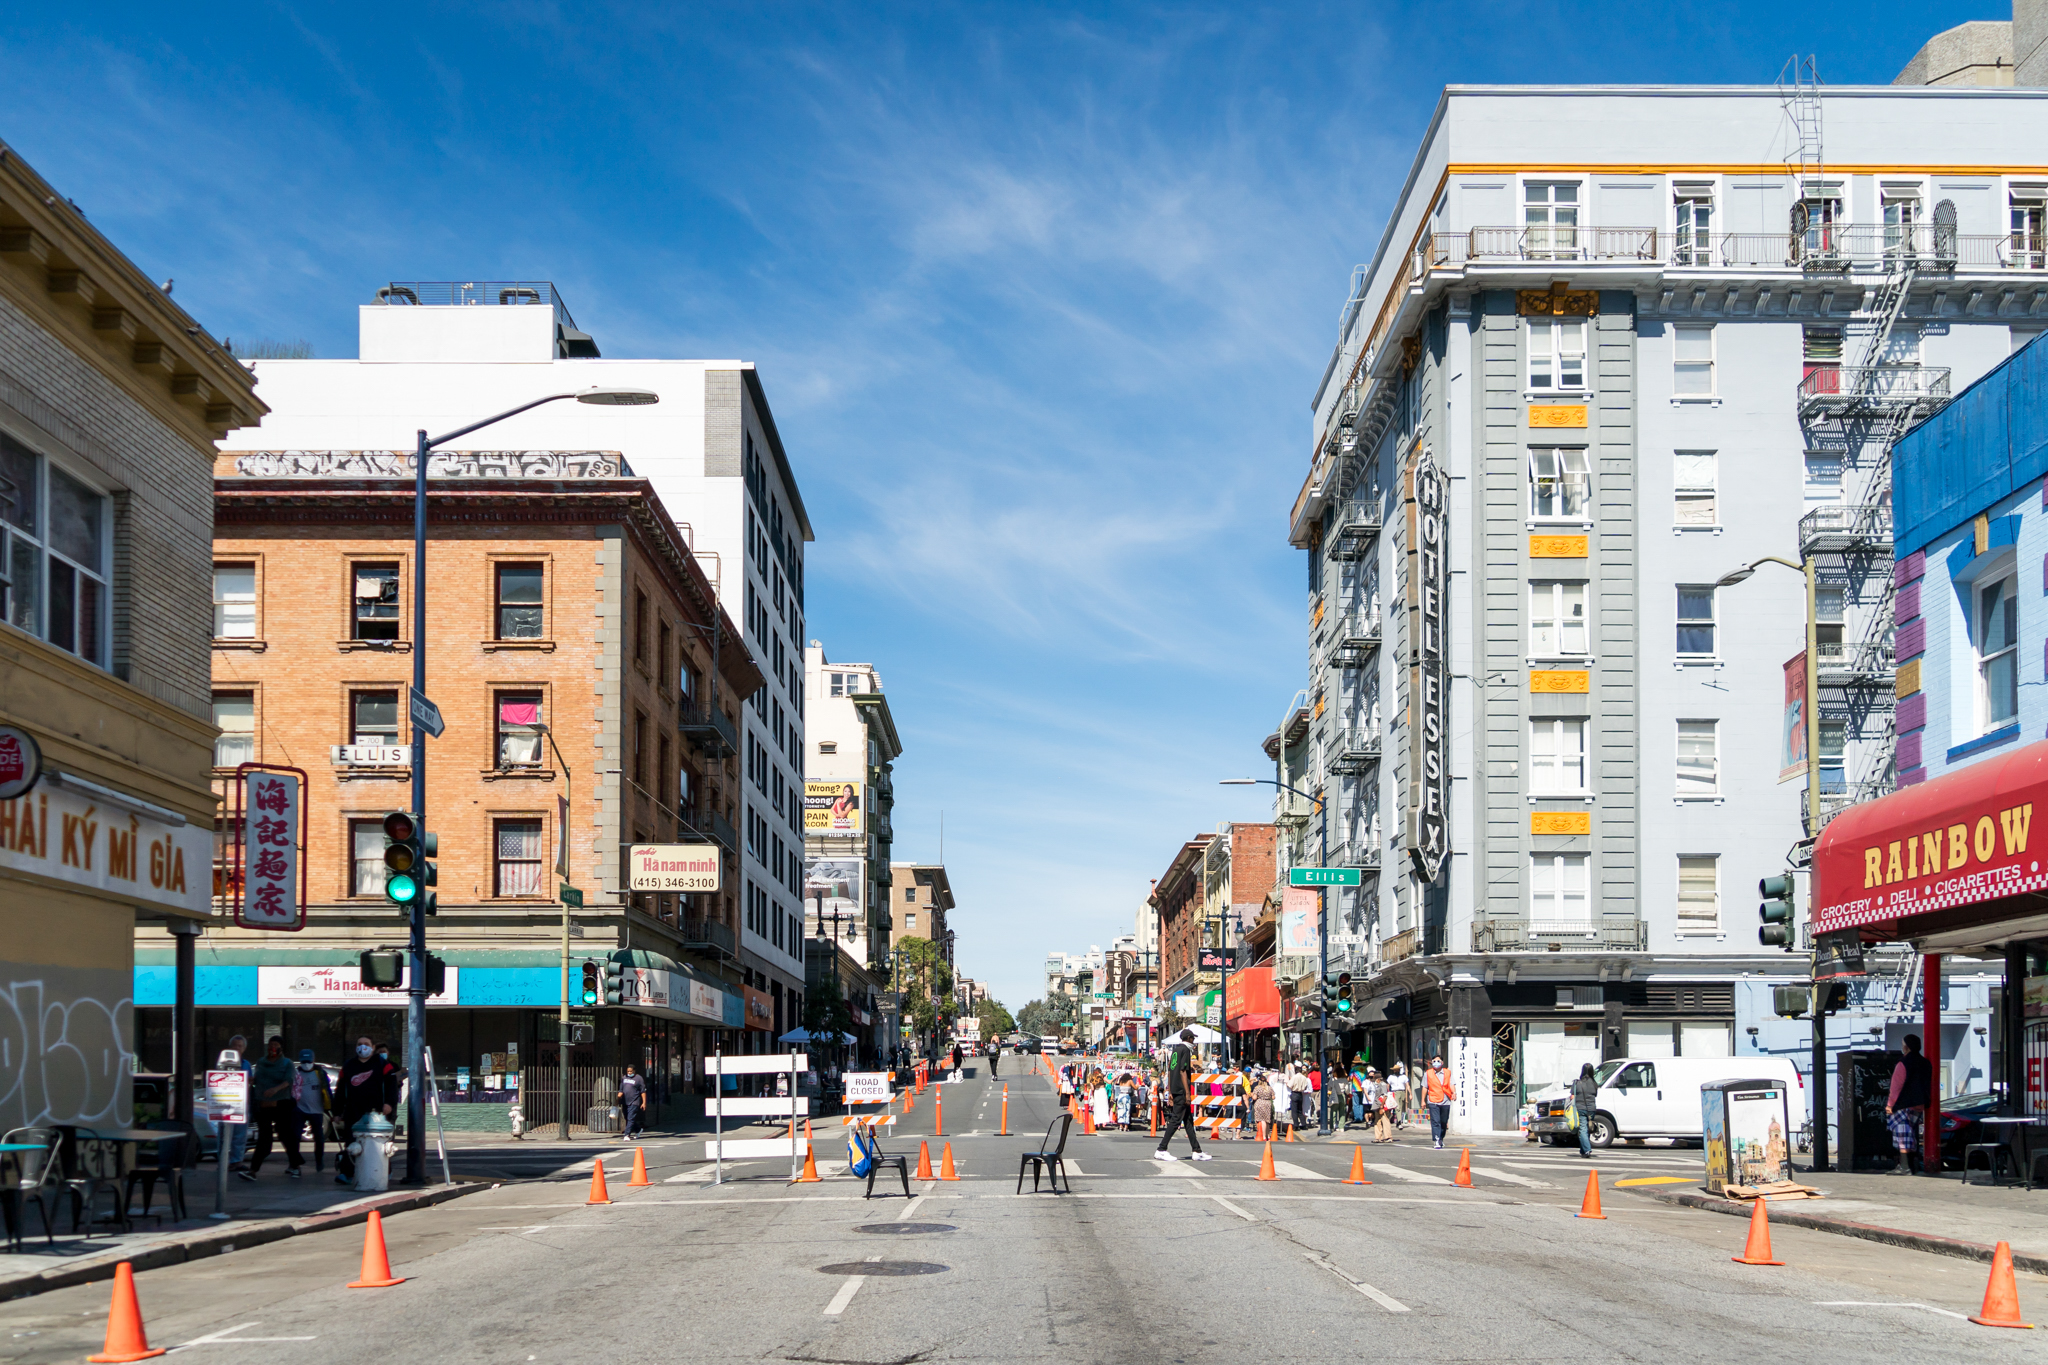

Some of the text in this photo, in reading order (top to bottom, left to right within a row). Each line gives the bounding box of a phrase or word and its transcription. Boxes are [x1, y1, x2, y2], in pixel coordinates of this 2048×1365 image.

[1423, 480, 1440, 855] HOTEL ESSEX
[339, 749, 401, 761] ELLIS
[808, 784, 841, 794] Wrong?
[804, 797, 834, 805] hoong!
[1864, 802, 2033, 889] RAINBOW
[633, 877, 715, 889] (415) 346-3100
[1305, 872, 1345, 882] Ellis
[563, 888, 580, 904] Larkin
[1820, 864, 2021, 920] GROCERY DELI CIGARETTES
[1113, 951, 1122, 1005] CENTURY
[626, 979, 651, 997] 701
[1208, 1016, 1218, 1024] 25
[855, 1078, 879, 1086] ROAD
[850, 1087, 884, 1095] CLOSED
